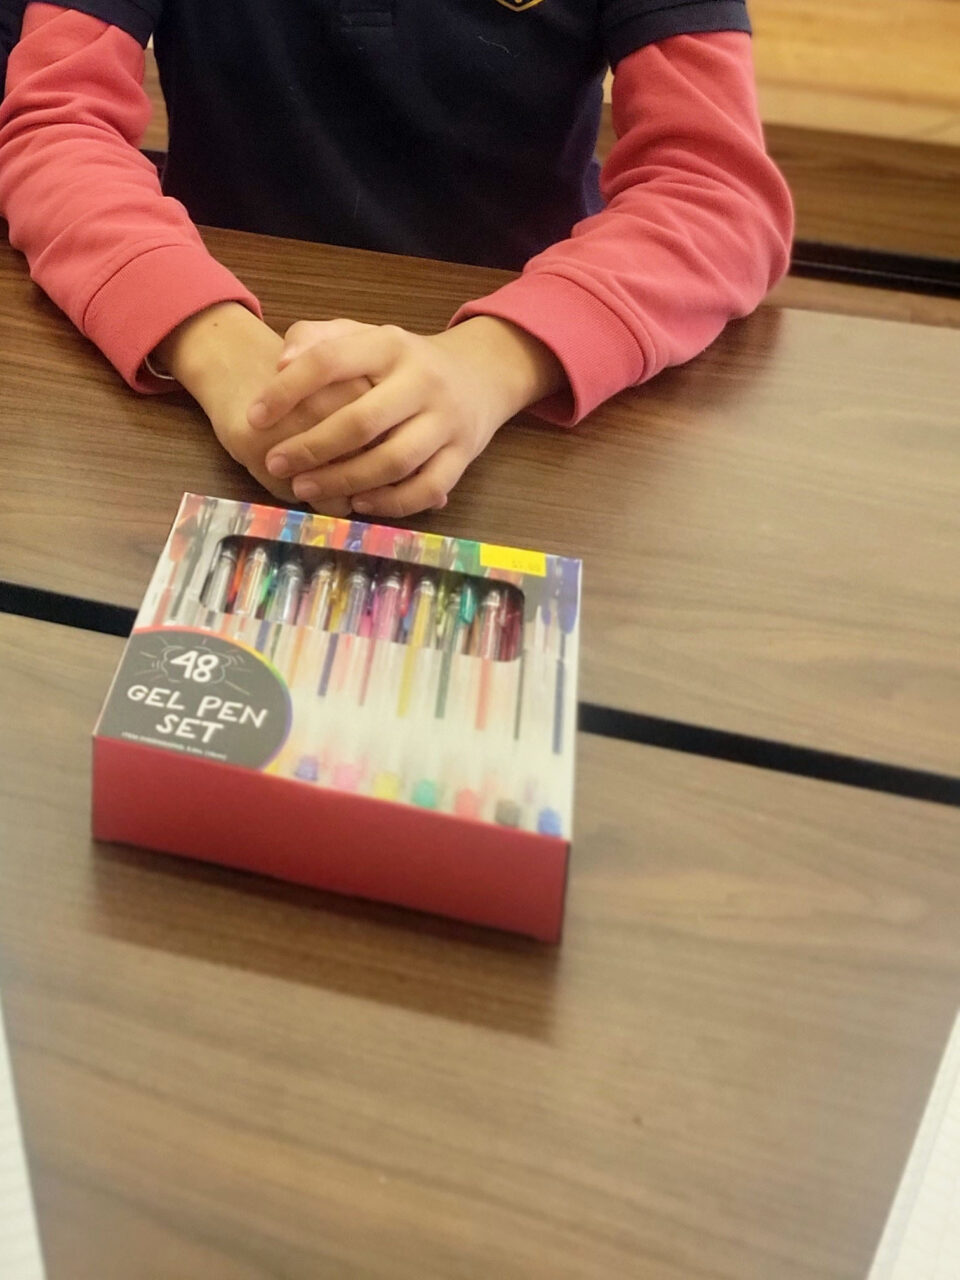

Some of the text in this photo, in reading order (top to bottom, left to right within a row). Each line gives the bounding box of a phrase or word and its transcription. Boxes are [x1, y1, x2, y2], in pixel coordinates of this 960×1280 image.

[170, 650, 219, 683] 48
[127, 684, 268, 729] GEL PEN
[155, 713, 224, 743] SET
